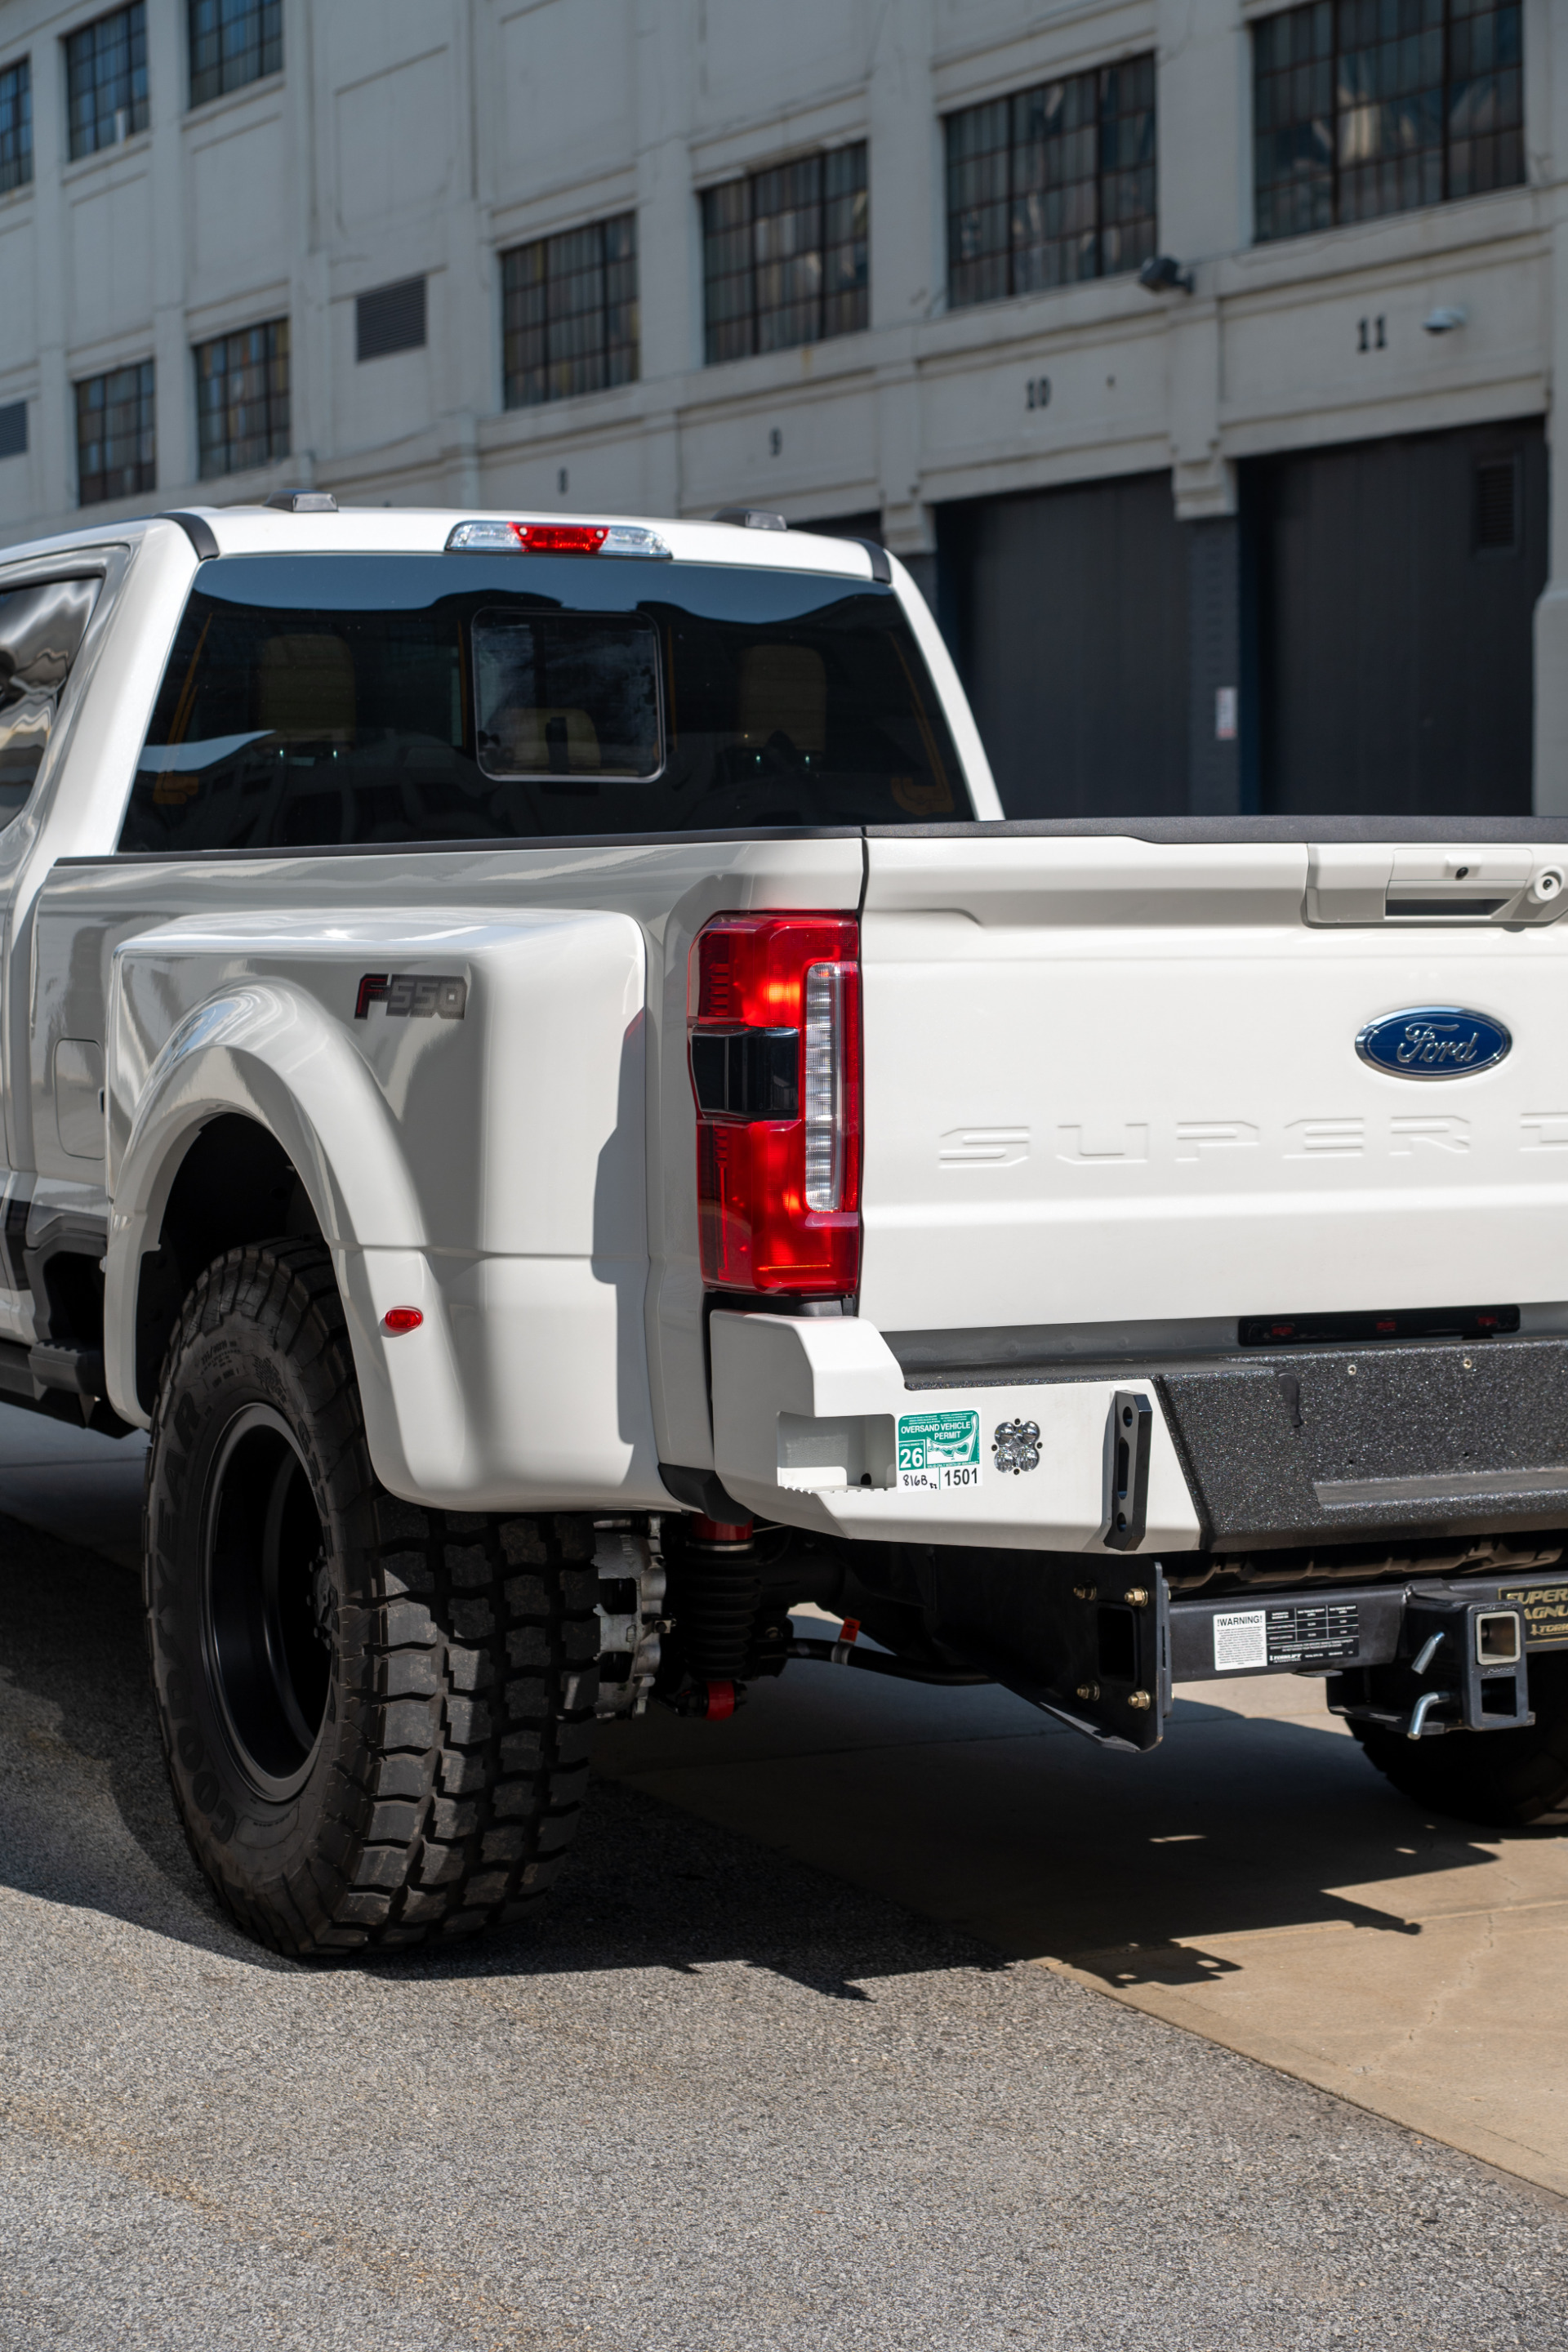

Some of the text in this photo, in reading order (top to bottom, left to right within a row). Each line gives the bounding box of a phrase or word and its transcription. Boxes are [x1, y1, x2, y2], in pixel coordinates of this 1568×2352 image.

[1357, 315, 1387, 353] 11
[1025, 376, 1051, 410] 10
[1396, 1022, 1478, 1062] Ford
[939, 1116, 1470, 1169] SUPER
[901, 1421, 971, 1434] OVERSAND VEHICLE
[934, 1431, 961, 1440] PERMIT
[900, 1447, 924, 1468] 26
[944, 1468, 978, 1486] 1501
[1217, 1615, 1263, 1627] !WARNING!
